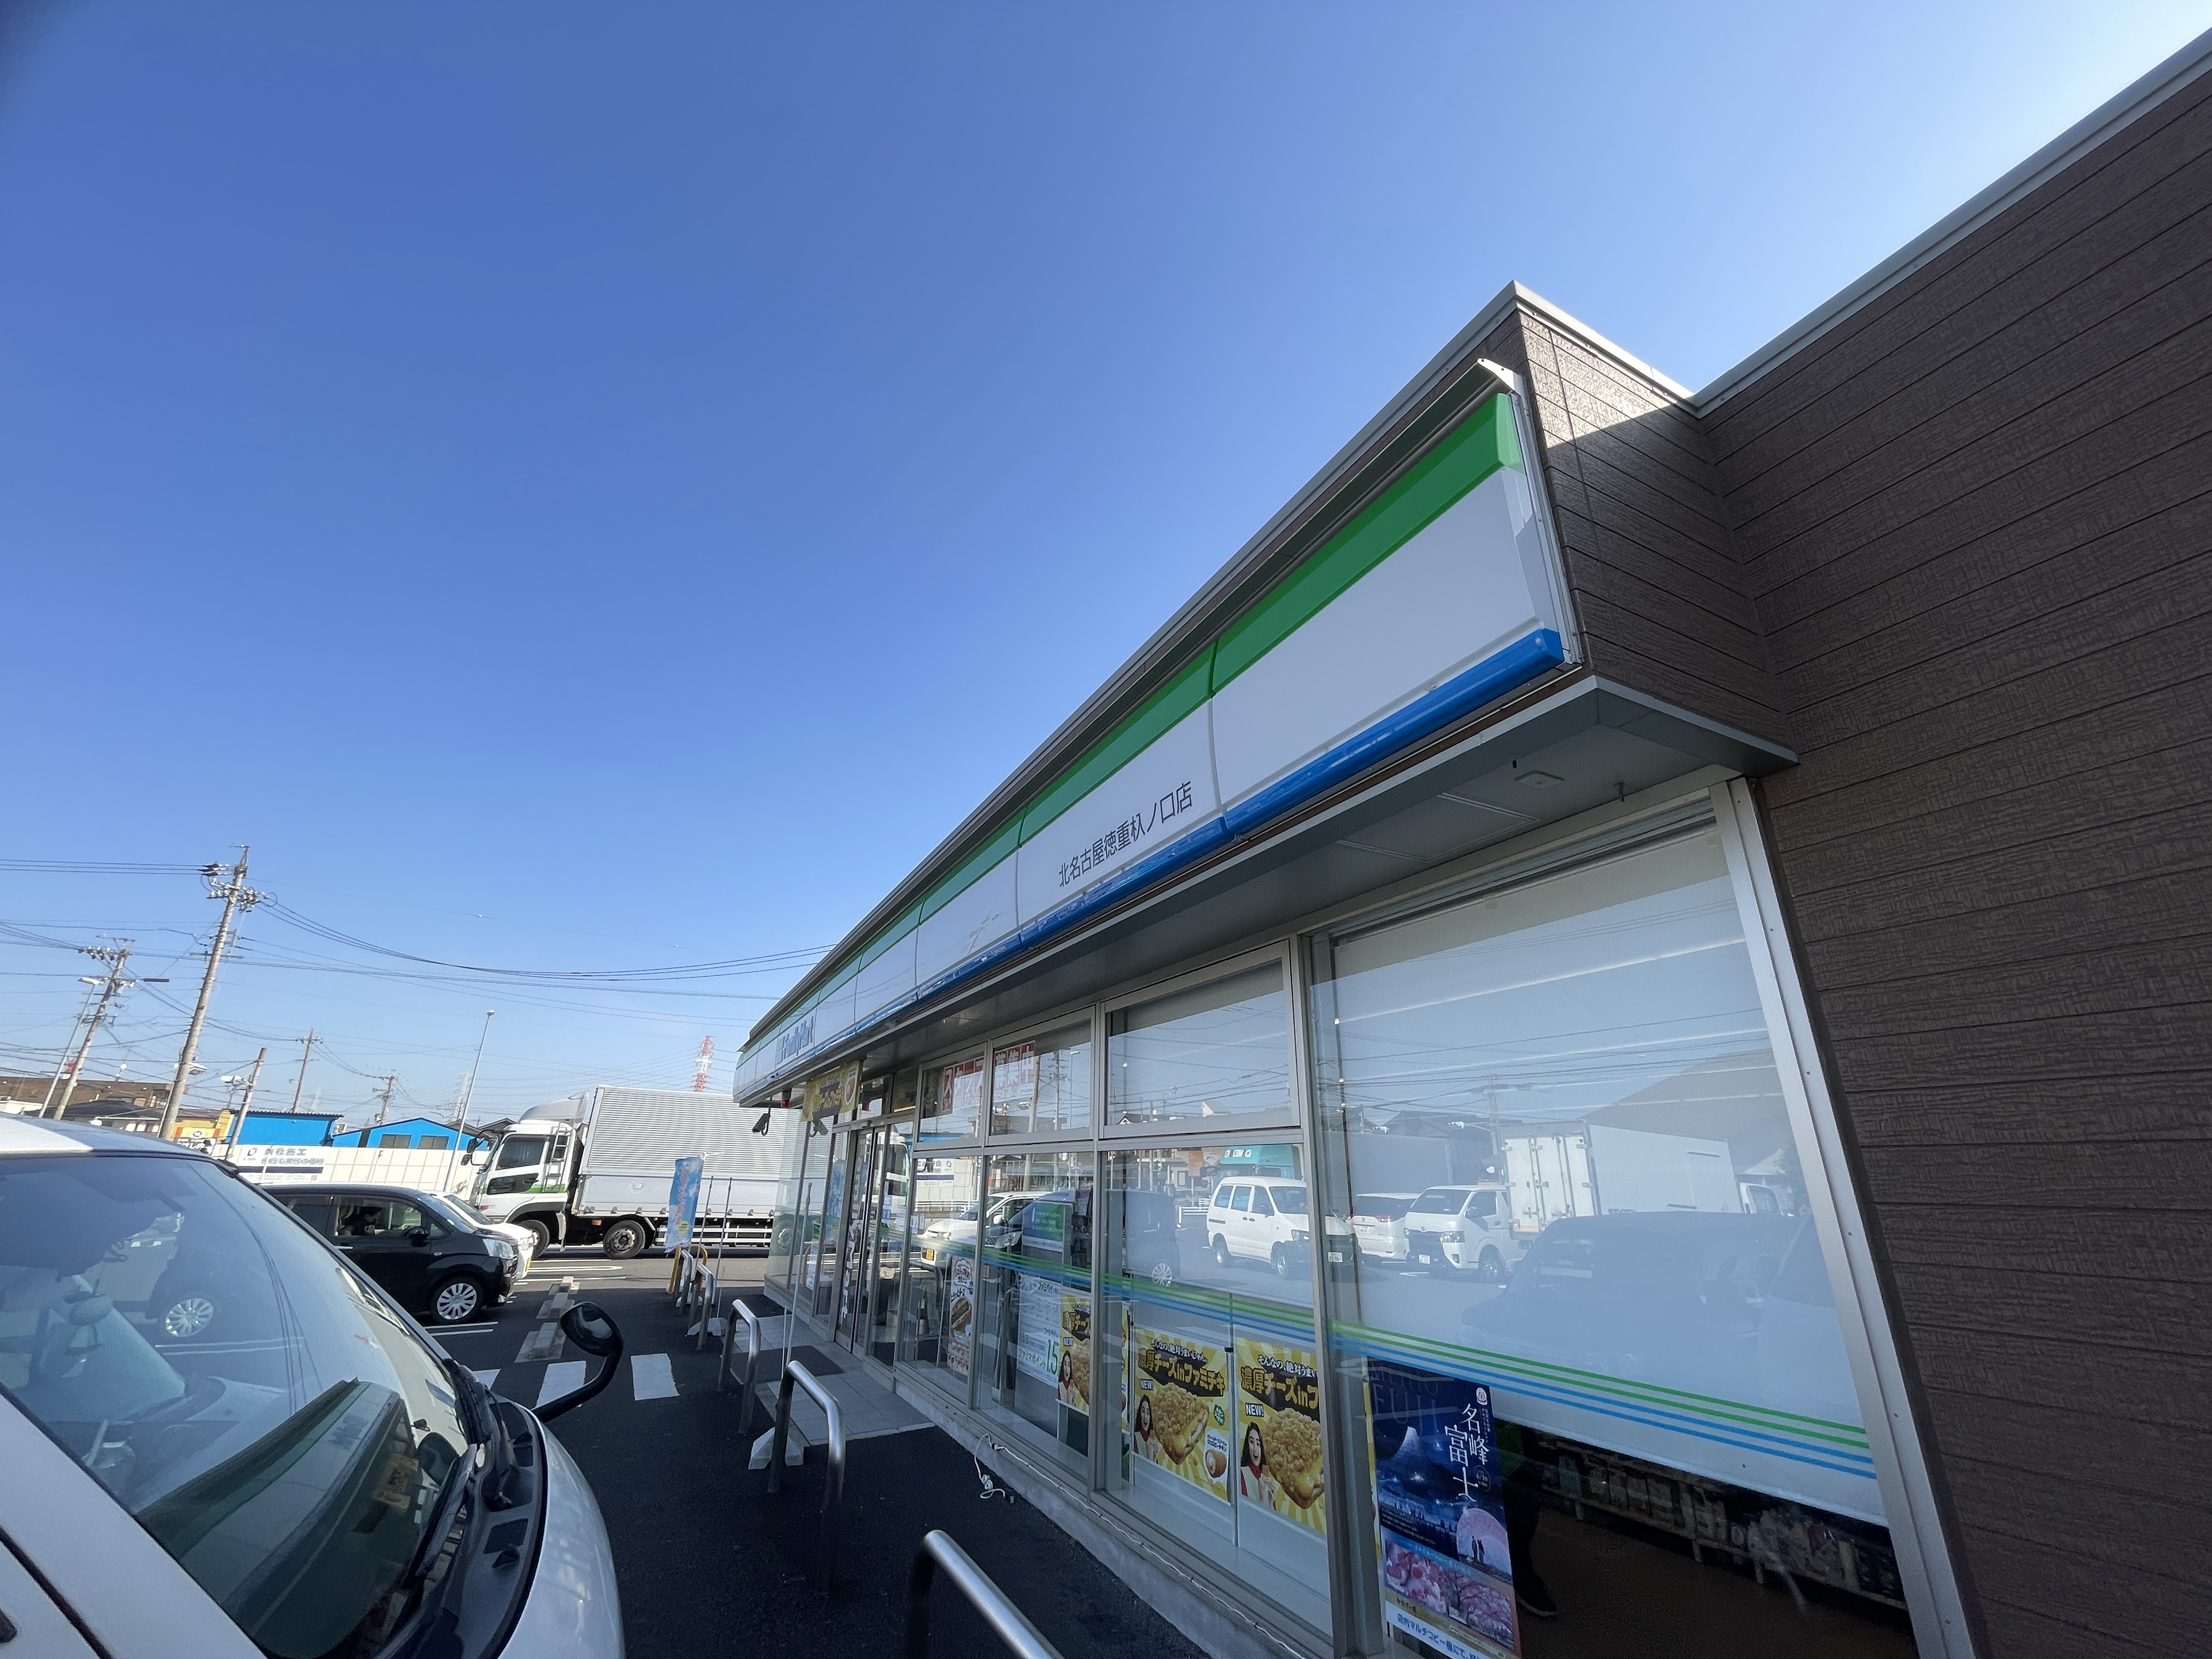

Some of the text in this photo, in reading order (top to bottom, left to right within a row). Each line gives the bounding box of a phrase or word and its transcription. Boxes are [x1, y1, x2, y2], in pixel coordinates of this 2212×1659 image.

[1258, 1355, 1318, 1378] そんなの、絶対うまい
[1245, 1403, 1263, 1417] NEW!
[1397, 1613, 1481, 1659] 店内マルチコピー機にて、
